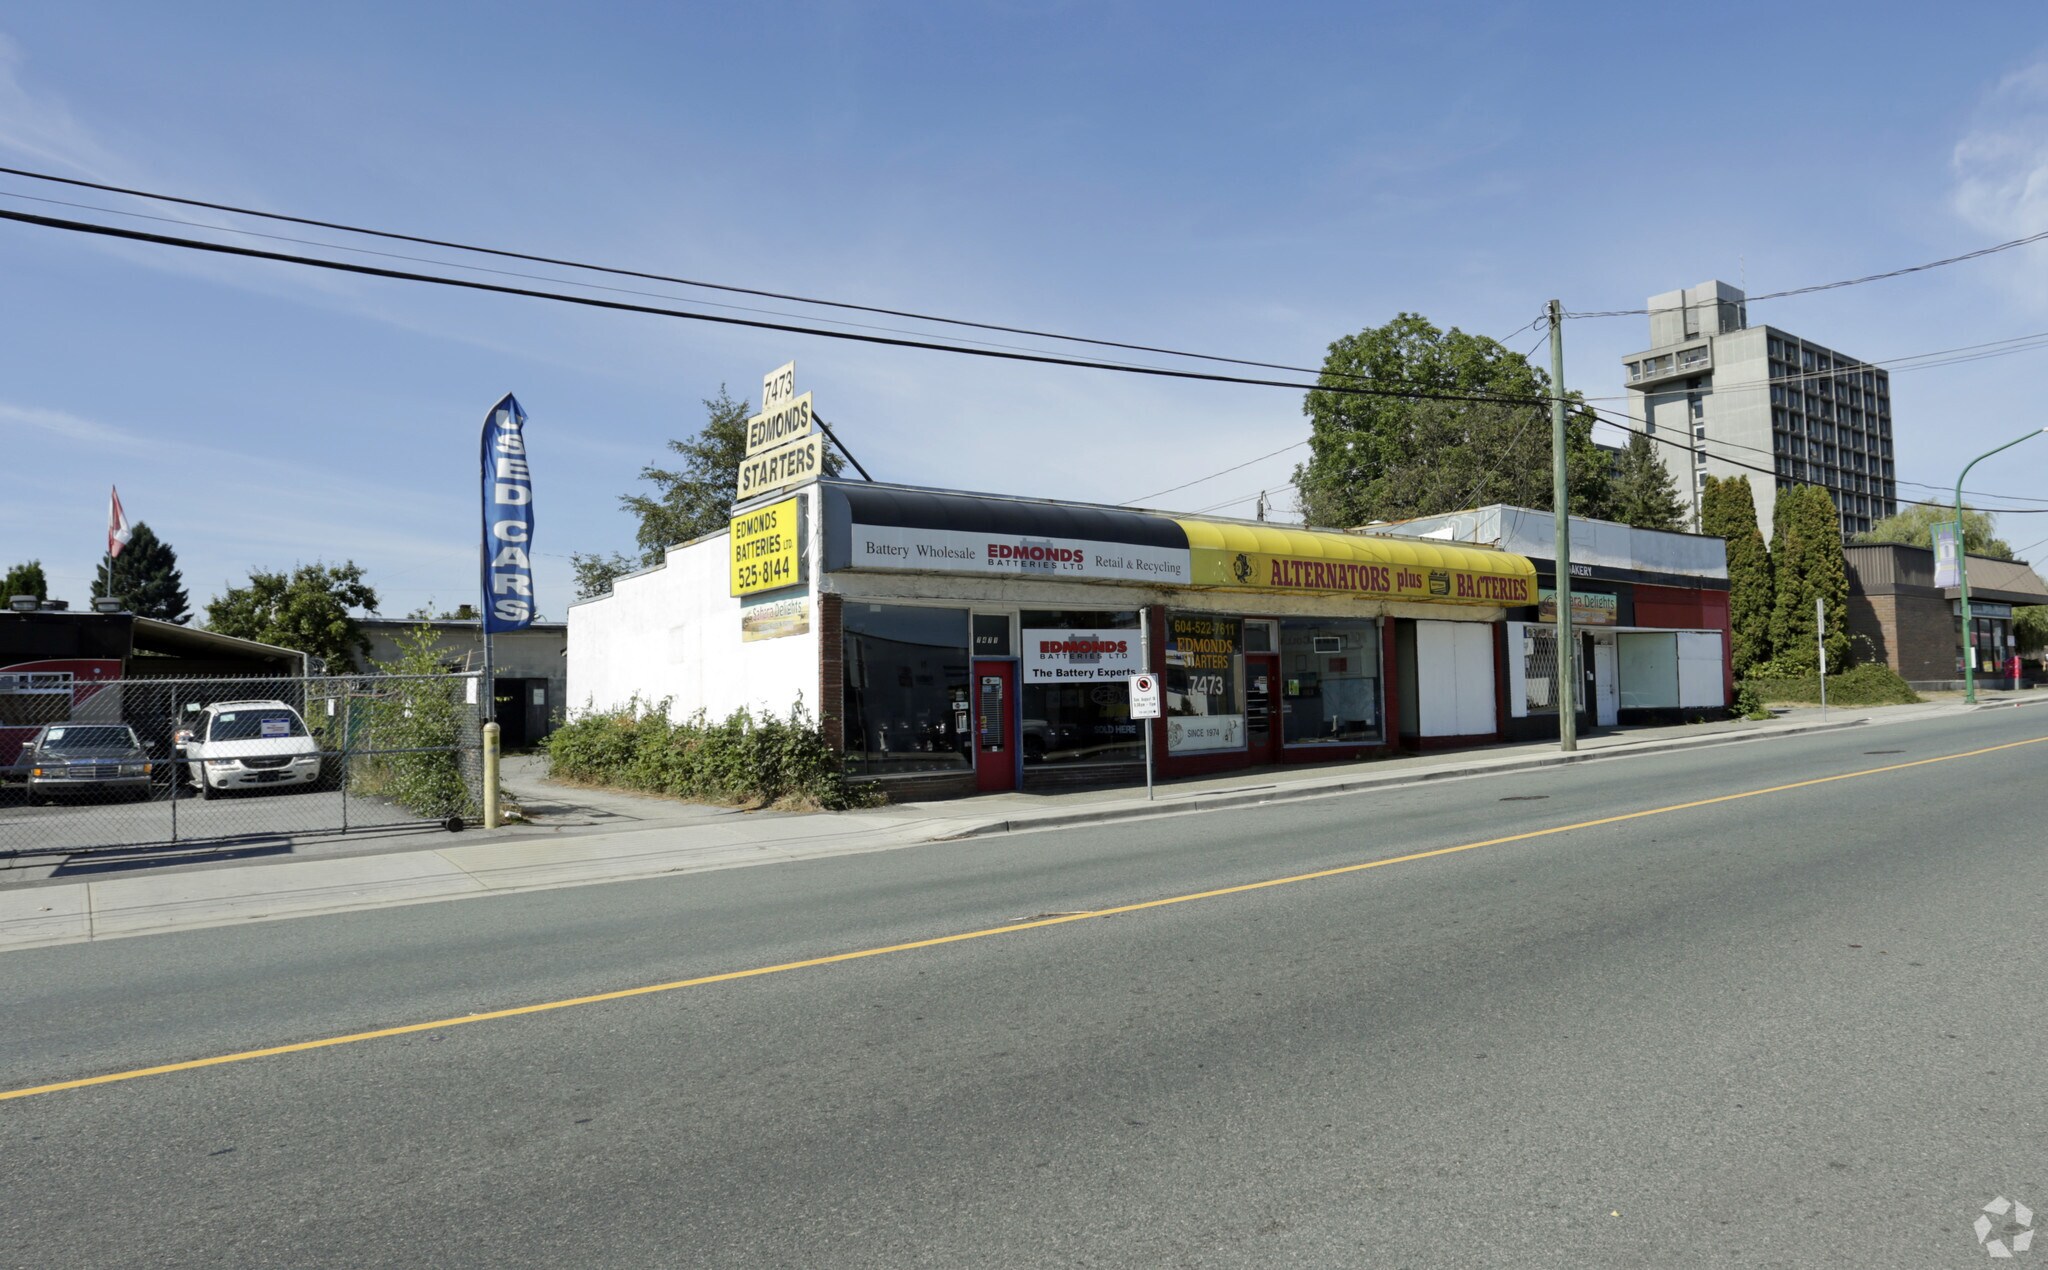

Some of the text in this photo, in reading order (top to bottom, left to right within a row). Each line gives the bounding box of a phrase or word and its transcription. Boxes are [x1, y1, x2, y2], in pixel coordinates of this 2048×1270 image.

[764, 370, 792, 404] 7473
[750, 401, 808, 449] EDMONDS
[495, 410, 532, 506] USED
[743, 443, 815, 491] STARTERS
[736, 510, 777, 540] EDMONDS
[736, 533, 781, 562] BATTERIES
[866, 541, 976, 560] Battery Wholesale
[987, 543, 1084, 564] EDMONDS
[491, 520, 532, 627] CARS
[987, 558, 1084, 571] BATTERIES LTD
[1095, 555, 1181, 576] Retail & Recycling
[1270, 559, 1528, 601] ALTERNATORS plus BATTERIES
[1174, 620, 1235, 636] 604-522-7611
[1040, 640, 1128, 654] EDMONDS
[1176, 637, 1233, 653] EDMONDS
[1040, 652, 1128, 660] BATTERIES LTD
[1183, 653, 1229, 669] STARTERS
[1032, 667, 1136, 679] The Battery Experts
[1189, 675, 1224, 695] 7473
[1115, 724, 1136, 734] HERE
[1187, 728, 1220, 738] SINCE 1974
